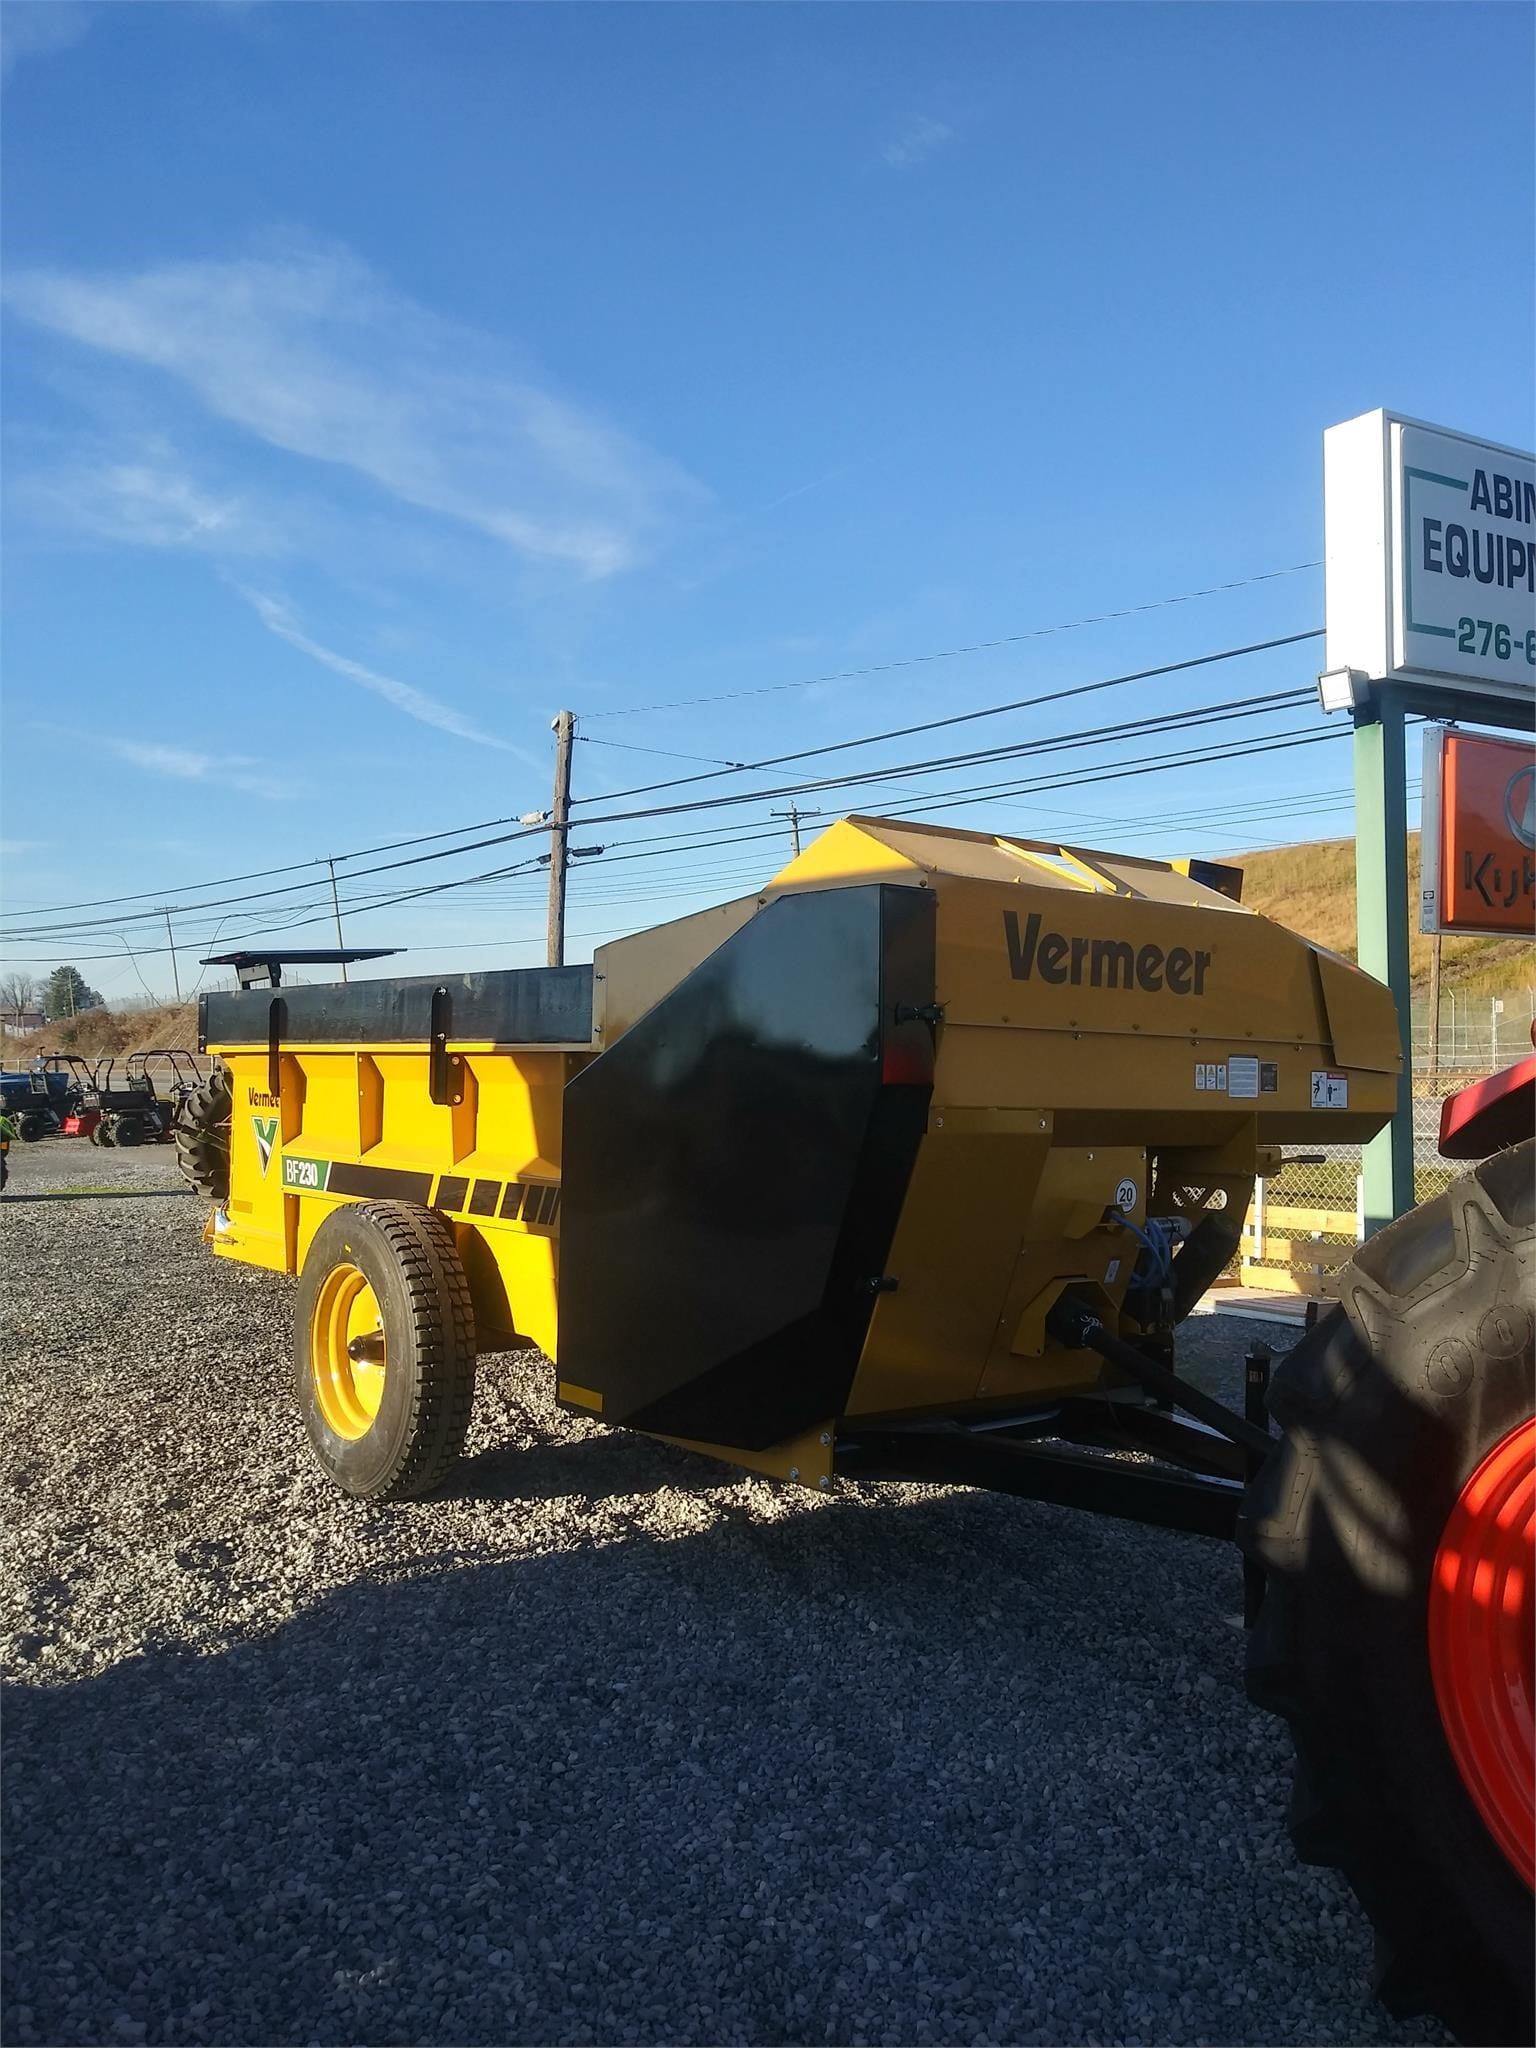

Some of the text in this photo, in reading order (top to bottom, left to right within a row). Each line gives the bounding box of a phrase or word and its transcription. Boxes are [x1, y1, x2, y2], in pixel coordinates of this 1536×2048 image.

[1003, 909, 1211, 996] Vermeer
[285, 1159, 318, 1187] BF230
[1119, 1187, 1133, 1202] 20
